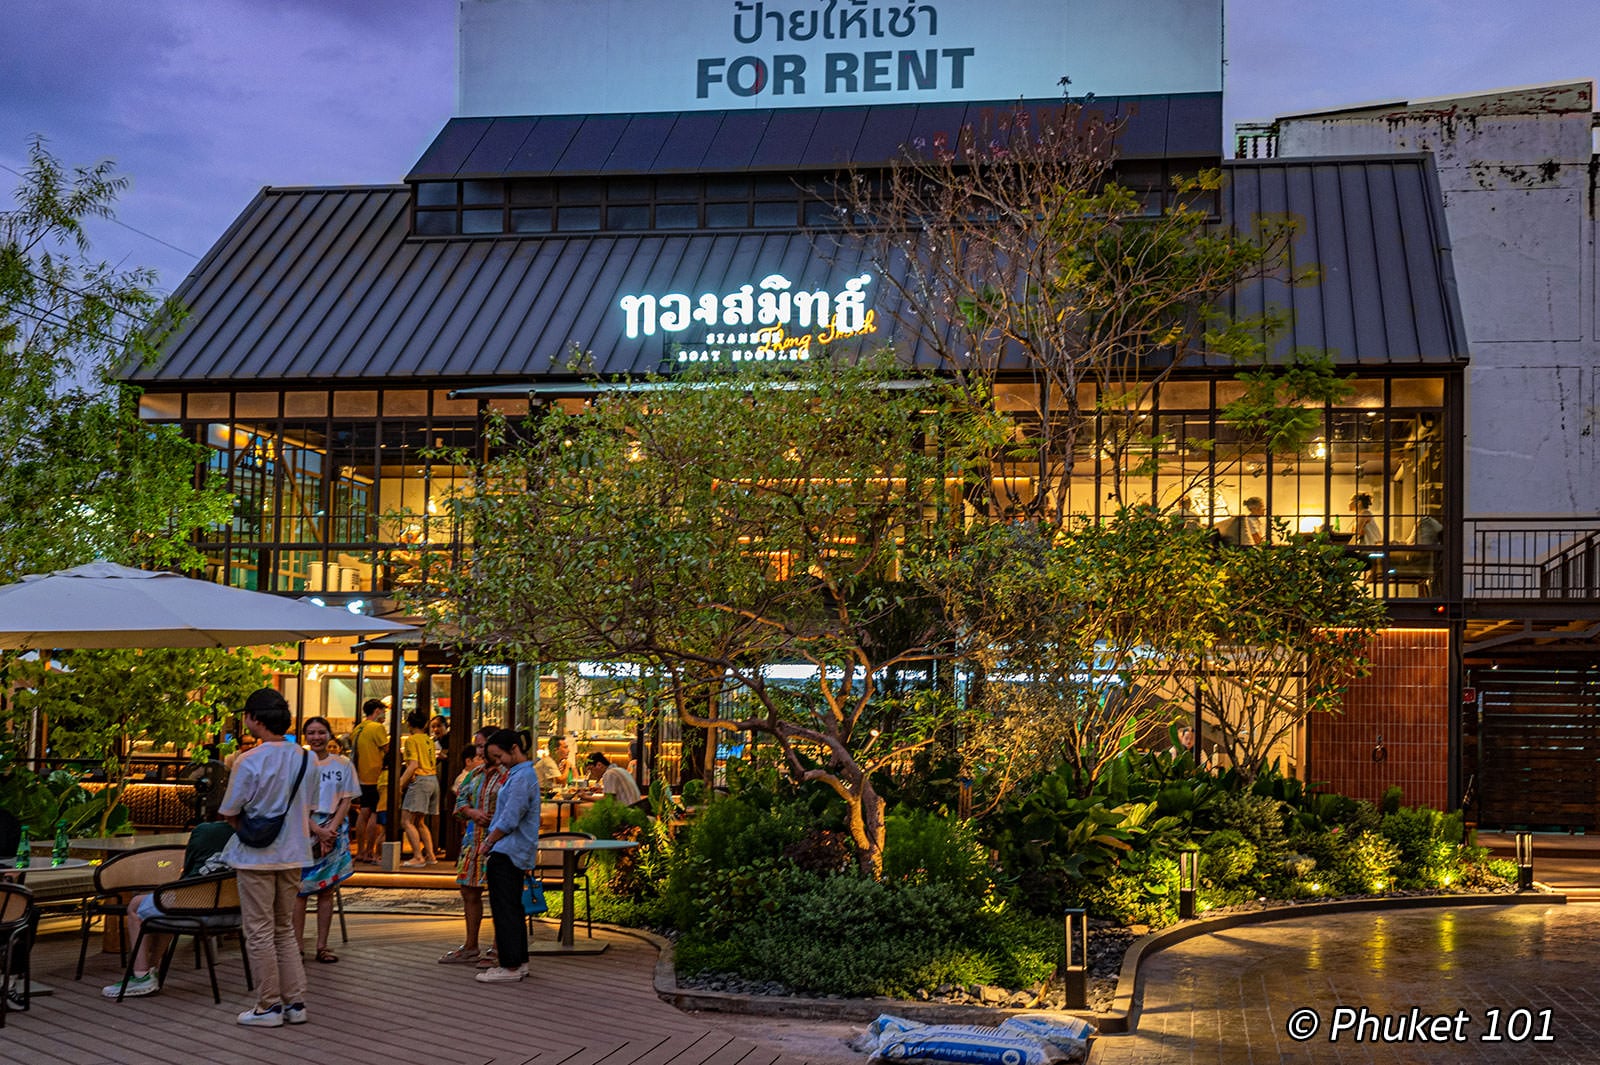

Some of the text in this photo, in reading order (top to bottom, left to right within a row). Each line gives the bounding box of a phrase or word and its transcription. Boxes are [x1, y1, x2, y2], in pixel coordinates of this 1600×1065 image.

[733, 0, 937, 44] ป้ายให้เช่า
[696, 47, 975, 99] FOR RENT
[619, 274, 873, 339] ทองสมิทธ์
[678, 349, 810, 362] BOAT NOODLES
[756, 308, 877, 360] Thong Smh
